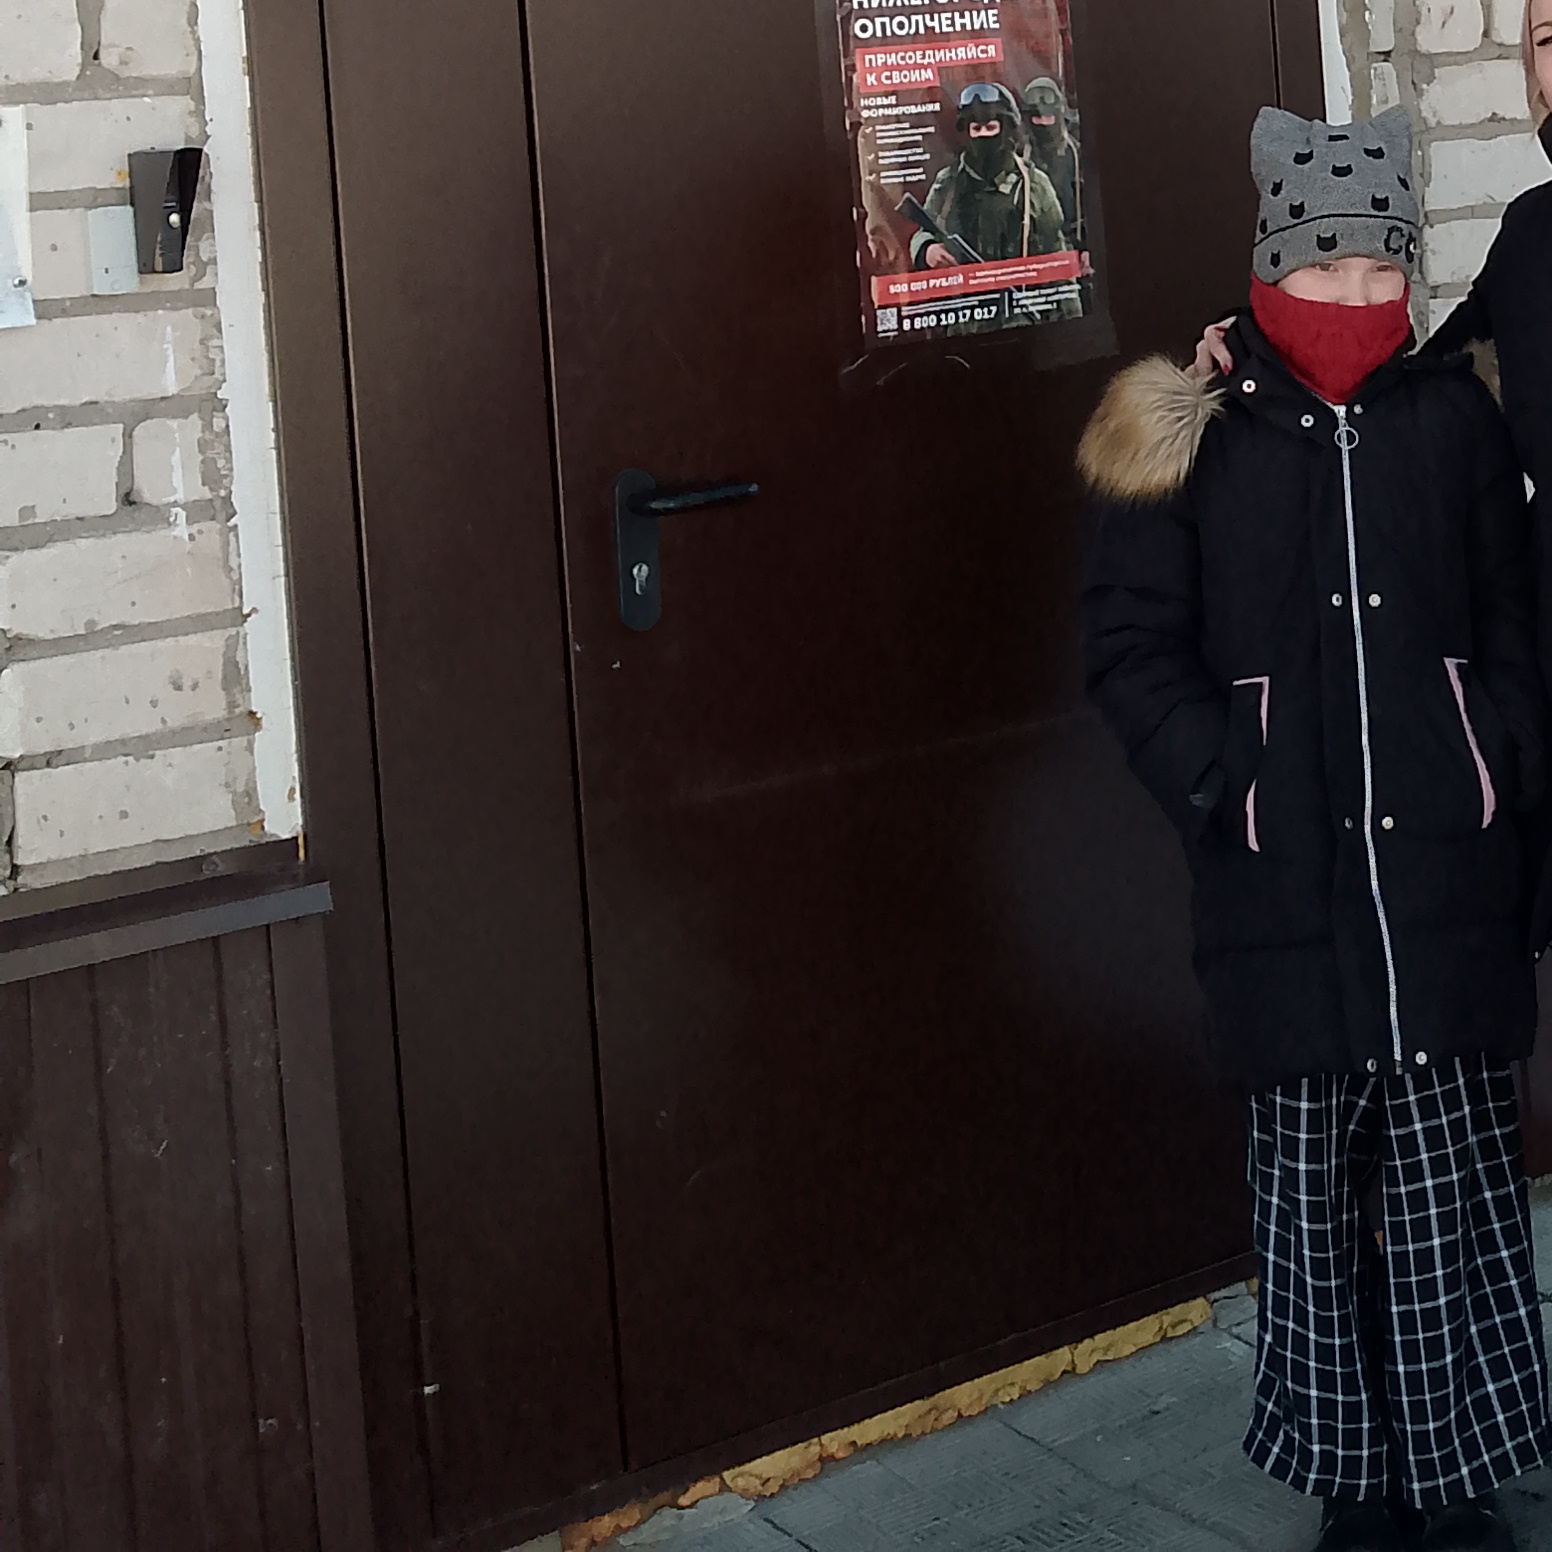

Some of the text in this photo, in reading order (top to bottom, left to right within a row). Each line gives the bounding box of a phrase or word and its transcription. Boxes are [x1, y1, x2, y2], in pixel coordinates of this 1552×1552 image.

[854, 9, 1000, 39] ОПОЛЧЕНИЕ
[864, 43, 997, 68] ПРИСОЕДИНЯЙСЯ
[866, 67, 935, 86] К СВОИМ
[860, 95, 897, 107] НОВЫЕ
[902, 318, 911, 331] 8
[913, 313, 938, 329] 800
[939, 312, 956, 326] 10
[957, 309, 972, 324] 17
[973, 305, 998, 321] 017
